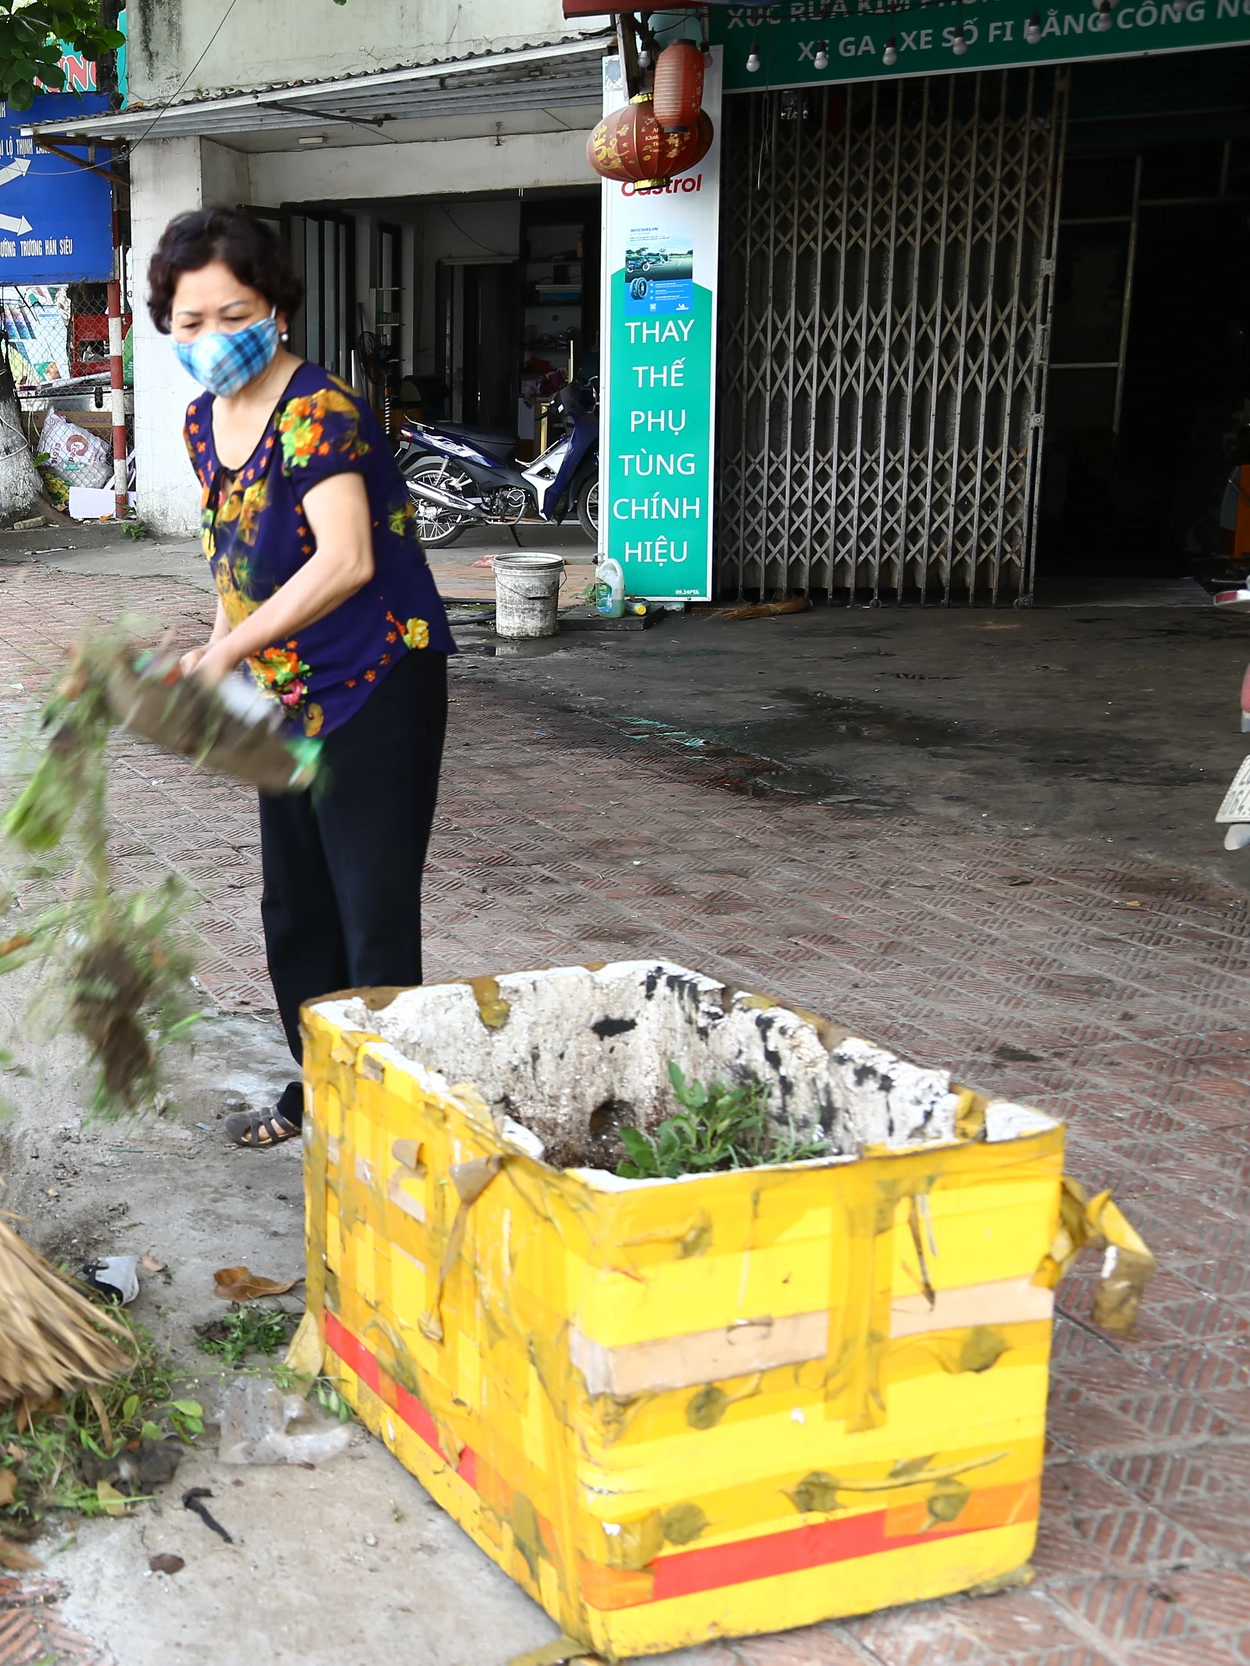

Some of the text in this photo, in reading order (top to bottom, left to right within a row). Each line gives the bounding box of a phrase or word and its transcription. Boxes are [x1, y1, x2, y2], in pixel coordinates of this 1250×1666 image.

[838, 35, 876, 57] GA
[899, 29, 934, 51] XE
[988, 21, 1014, 43] FI
[16, 138, 33, 158] THỊNH
[44, 235, 57, 256] HÁN
[59, 235, 73, 255] SIÊU
[625, 319, 695, 343] THAY
[632, 357, 686, 388] THẾ
[630, 409, 686, 436] PHỤ
[618, 448, 696, 476] TÙNG
[613, 492, 700, 520] CHÍNH
[624, 535, 688, 567] HIỆU
